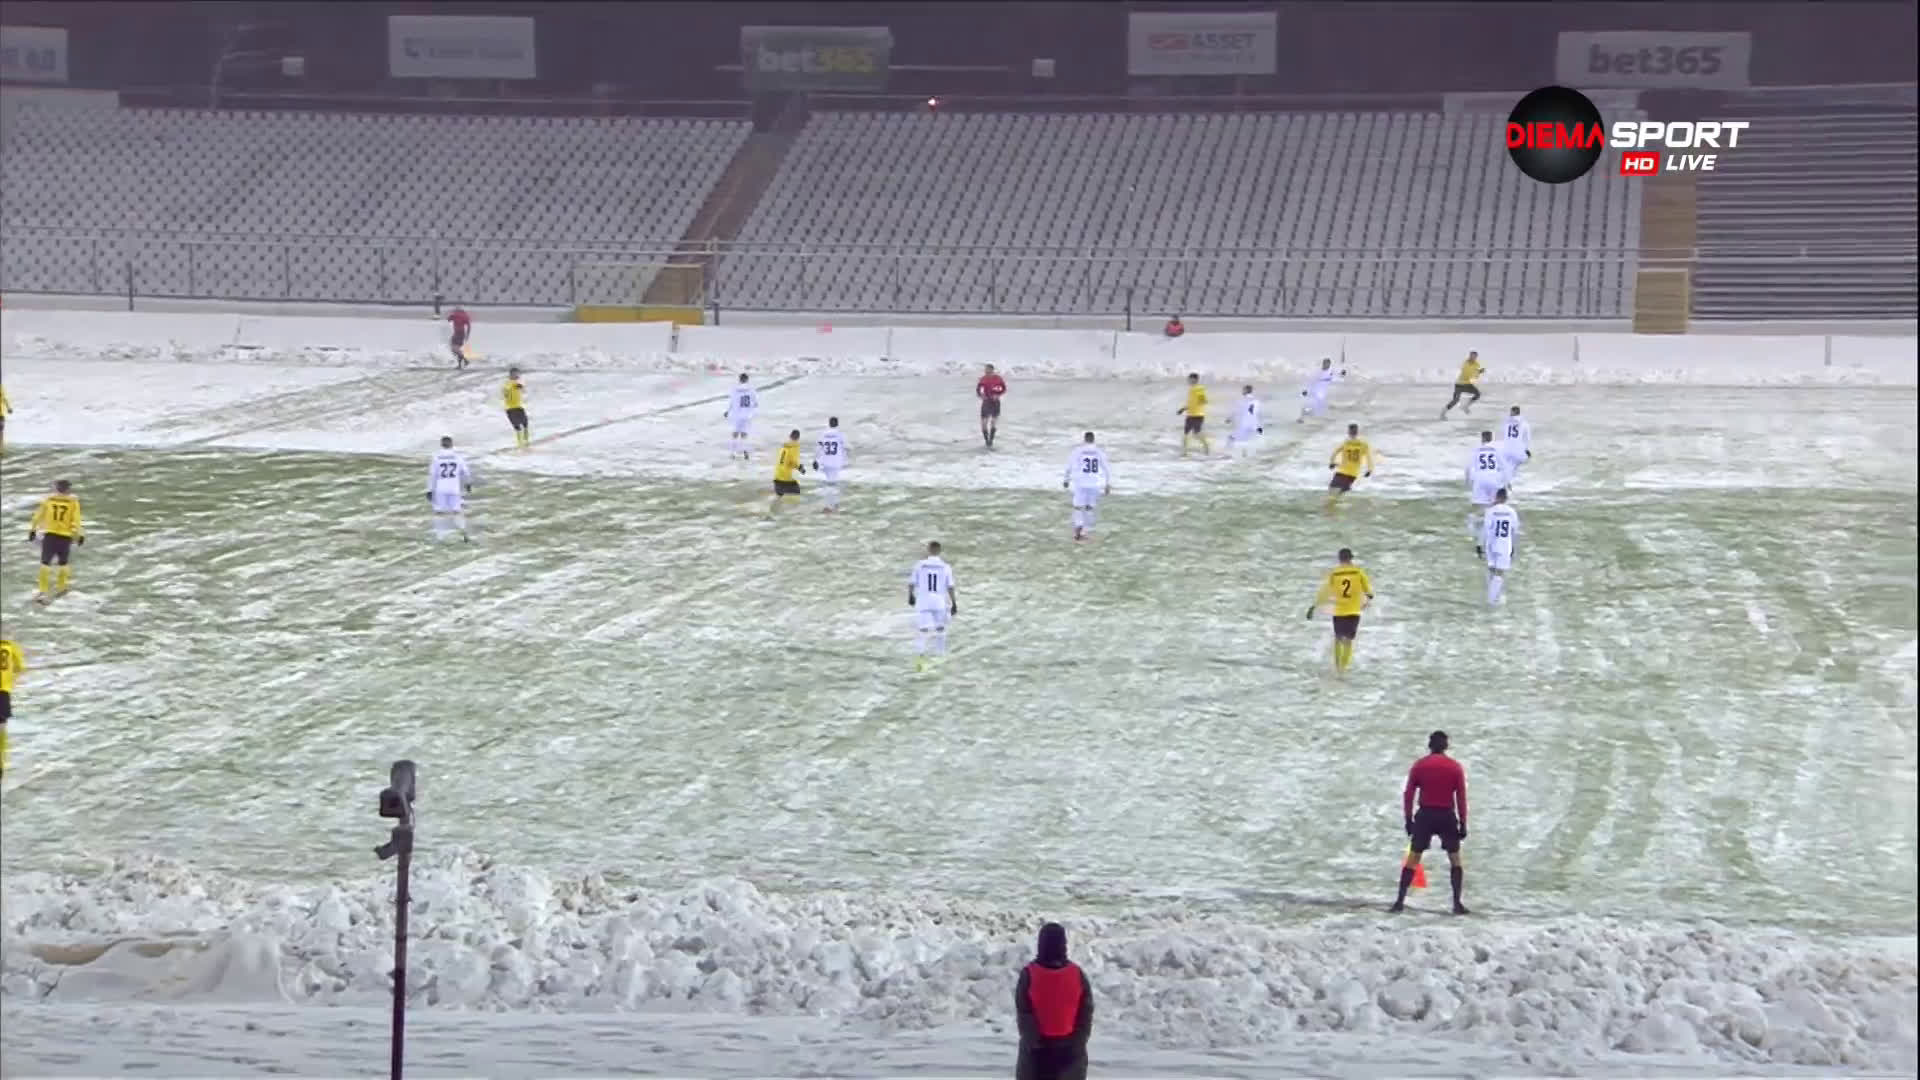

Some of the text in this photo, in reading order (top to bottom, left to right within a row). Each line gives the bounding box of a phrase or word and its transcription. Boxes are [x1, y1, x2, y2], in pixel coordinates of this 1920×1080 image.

[758, 43, 873, 72] bet365
[1588, 43, 1721, 74] bet365
[1507, 425, 1519, 438] 15
[823, 441, 838, 455] 33
[439, 461, 457, 478] 22
[1082, 457, 1099, 473] 38
[1479, 454, 1496, 470] 55
[52, 504, 68, 521] 17
[1495, 519, 1509, 537] 19
[927, 573, 937, 591] 11
[1340, 578, 1352, 598] 2
